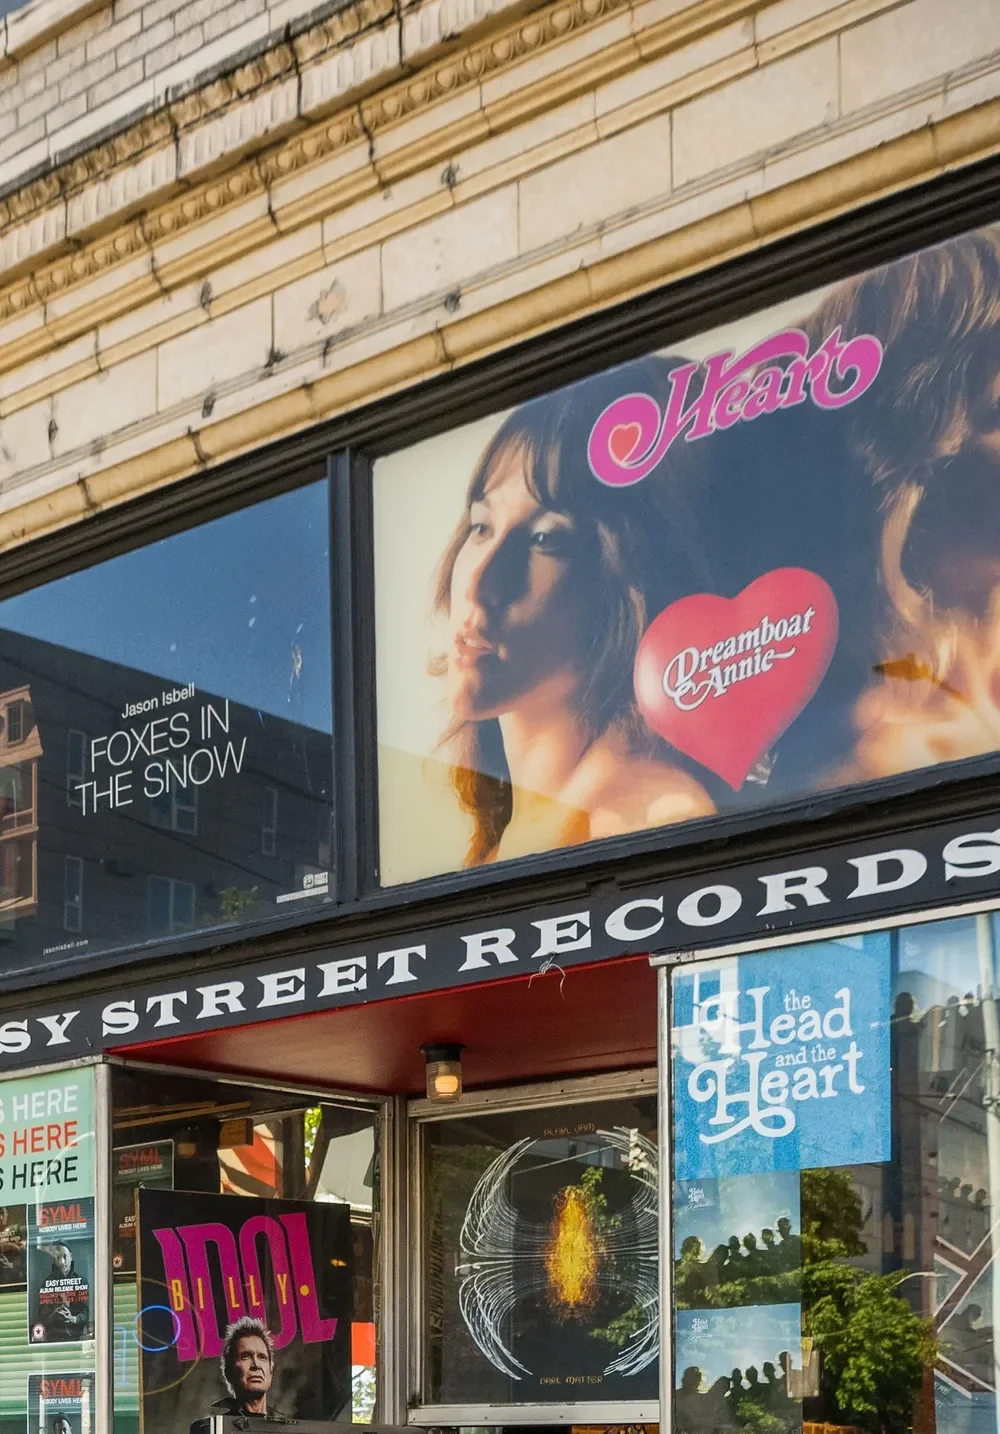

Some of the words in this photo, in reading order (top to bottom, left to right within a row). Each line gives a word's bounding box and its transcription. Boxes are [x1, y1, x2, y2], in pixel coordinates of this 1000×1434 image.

[587, 324, 884, 488] Heart
[662, 605, 817, 700] Dreamboat
[671, 645, 796, 712] Annie
[121, 696, 159, 719] Jason
[162, 682, 195, 707] Isbell
[91, 712, 190, 773] FOXES
[201, 699, 229, 740] IN
[74, 770, 133, 816] THE
[143, 736, 247, 798] SNOW
[102, 944, 427, 1037] STREET
[457, 829, 1000, 972] RECORDS
[783, 988, 811, 1012] the
[700, 986, 853, 1054] Head
[775, 1045, 807, 1068] and
[811, 1043, 836, 1063] the
[12, 1085, 79, 1121] HERE
[687, 1041, 866, 1145] Heart
[13, 1120, 79, 1156] HERE
[12, 1156, 79, 1190] HERE
[39, 1204, 87, 1228] SYML
[45, 1279, 59, 1288] EASY
[60, 1278, 82, 1286] STREET
[152, 1212, 338, 1362] IDOL
[171, 1273, 288, 1312] BILLY
[40, 1379, 84, 1398] SYML
